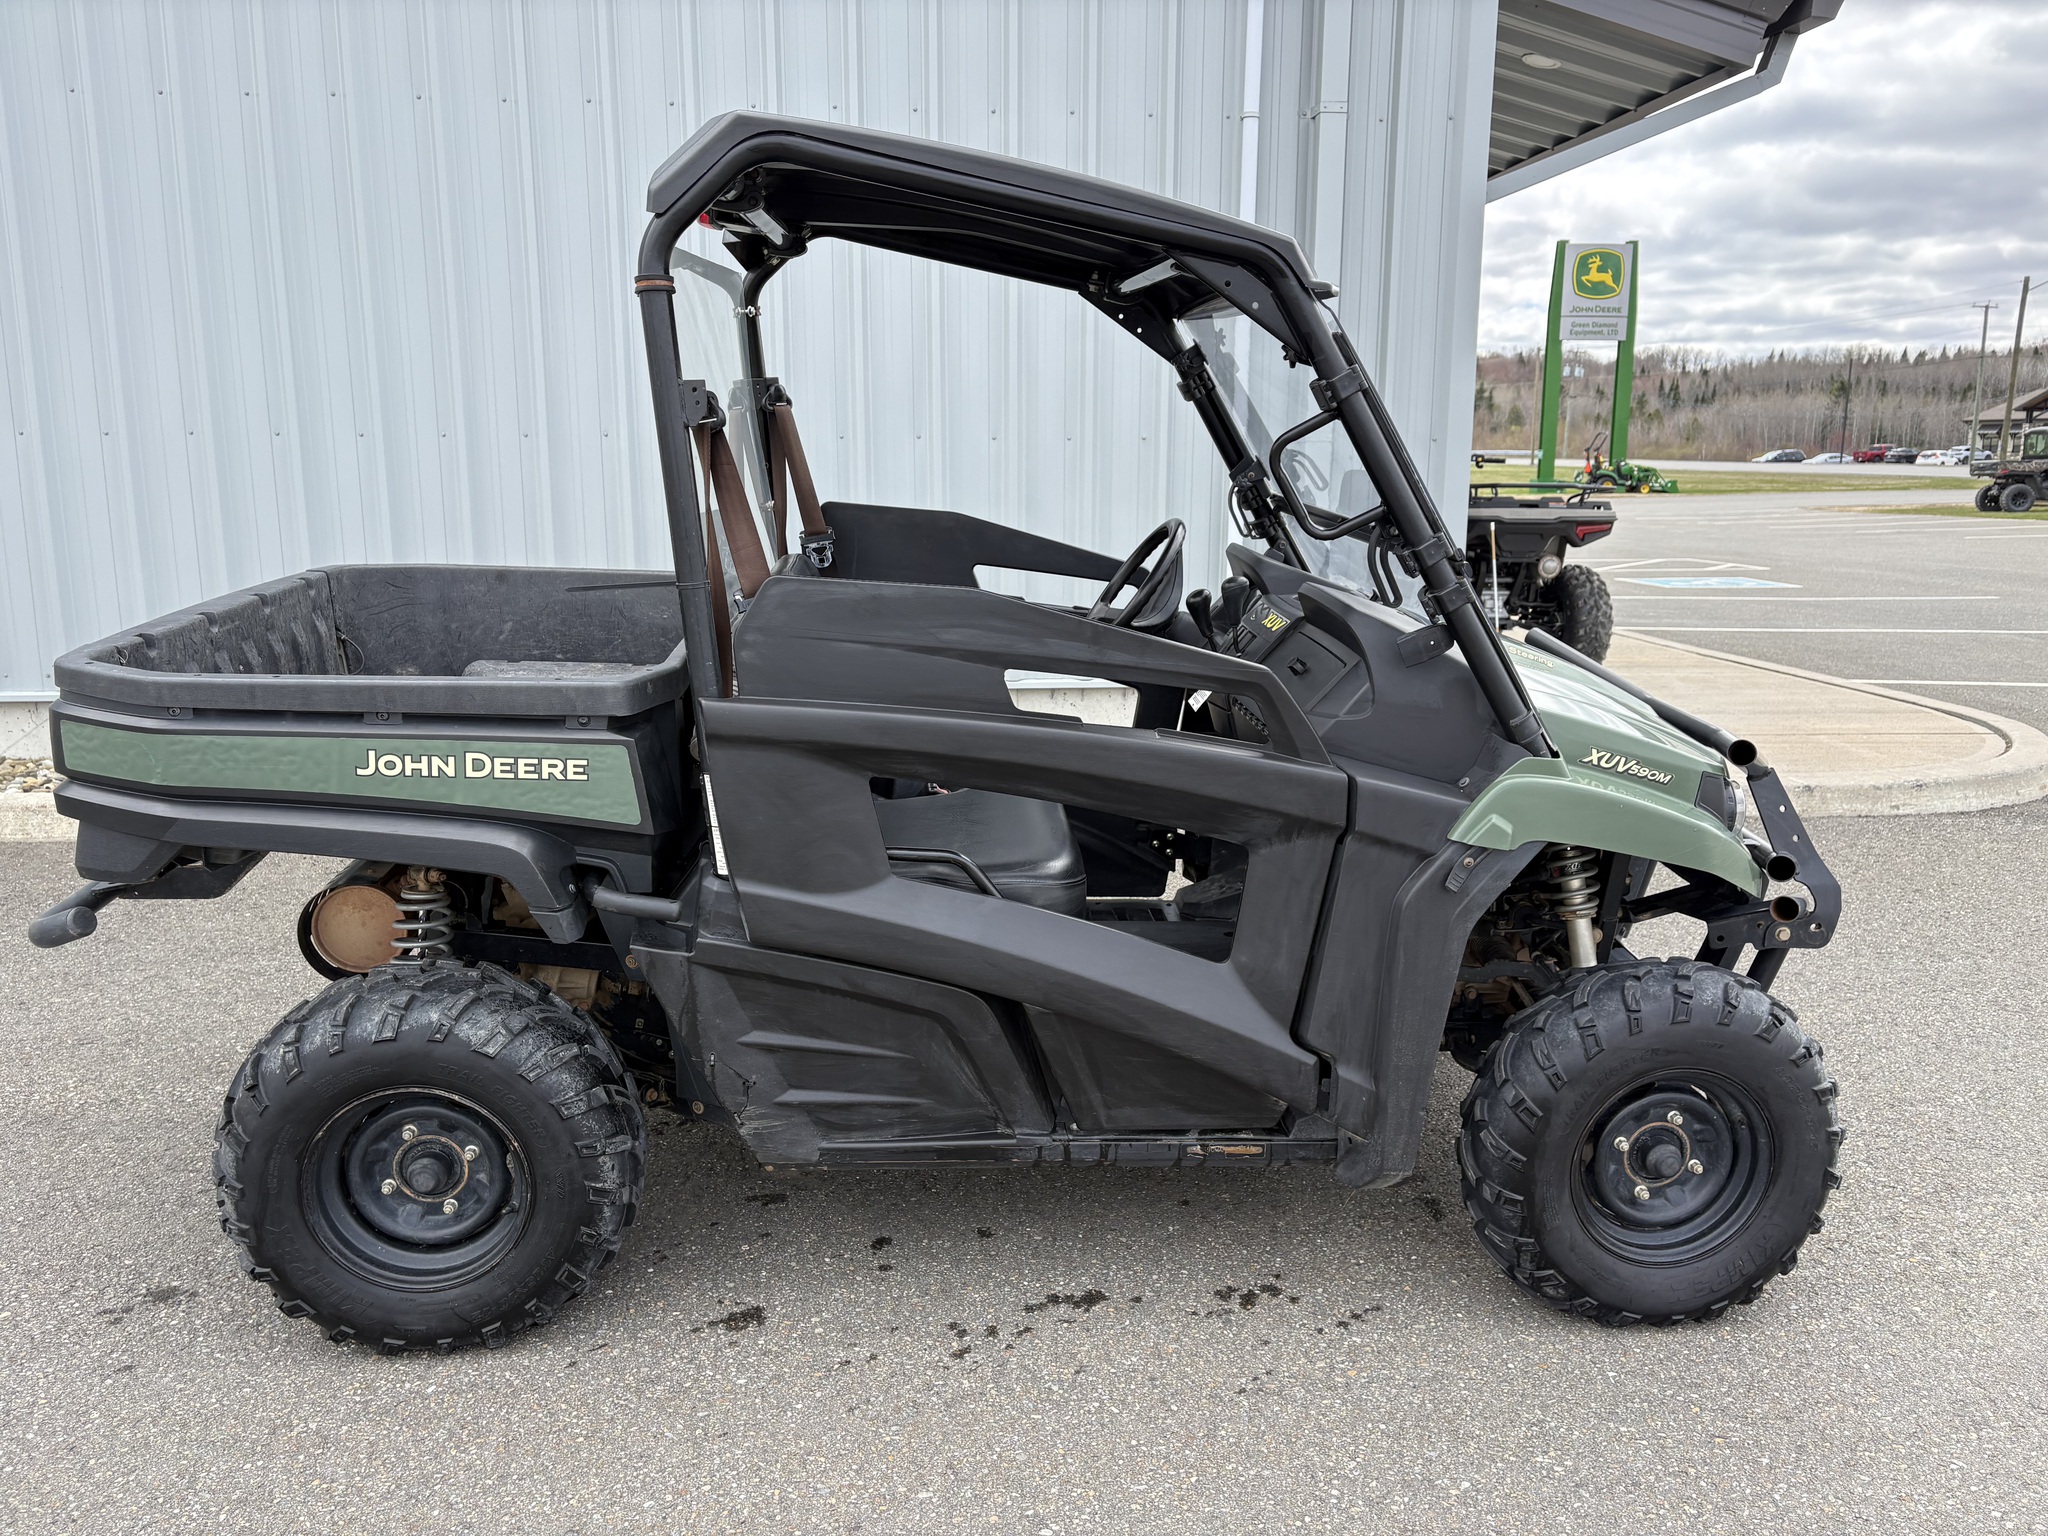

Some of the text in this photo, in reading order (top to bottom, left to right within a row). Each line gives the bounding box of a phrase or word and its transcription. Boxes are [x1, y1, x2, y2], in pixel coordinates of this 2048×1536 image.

[1570, 305, 1622, 313] JOHN DEERE
[1261, 612, 1287, 632] XUV
[1508, 646, 1554, 668] Steering
[355, 749, 589, 781] JOHN DEERE
[437, 1062, 484, 1086] TRAIL
[490, 1085, 546, 1137] FIGHTER
